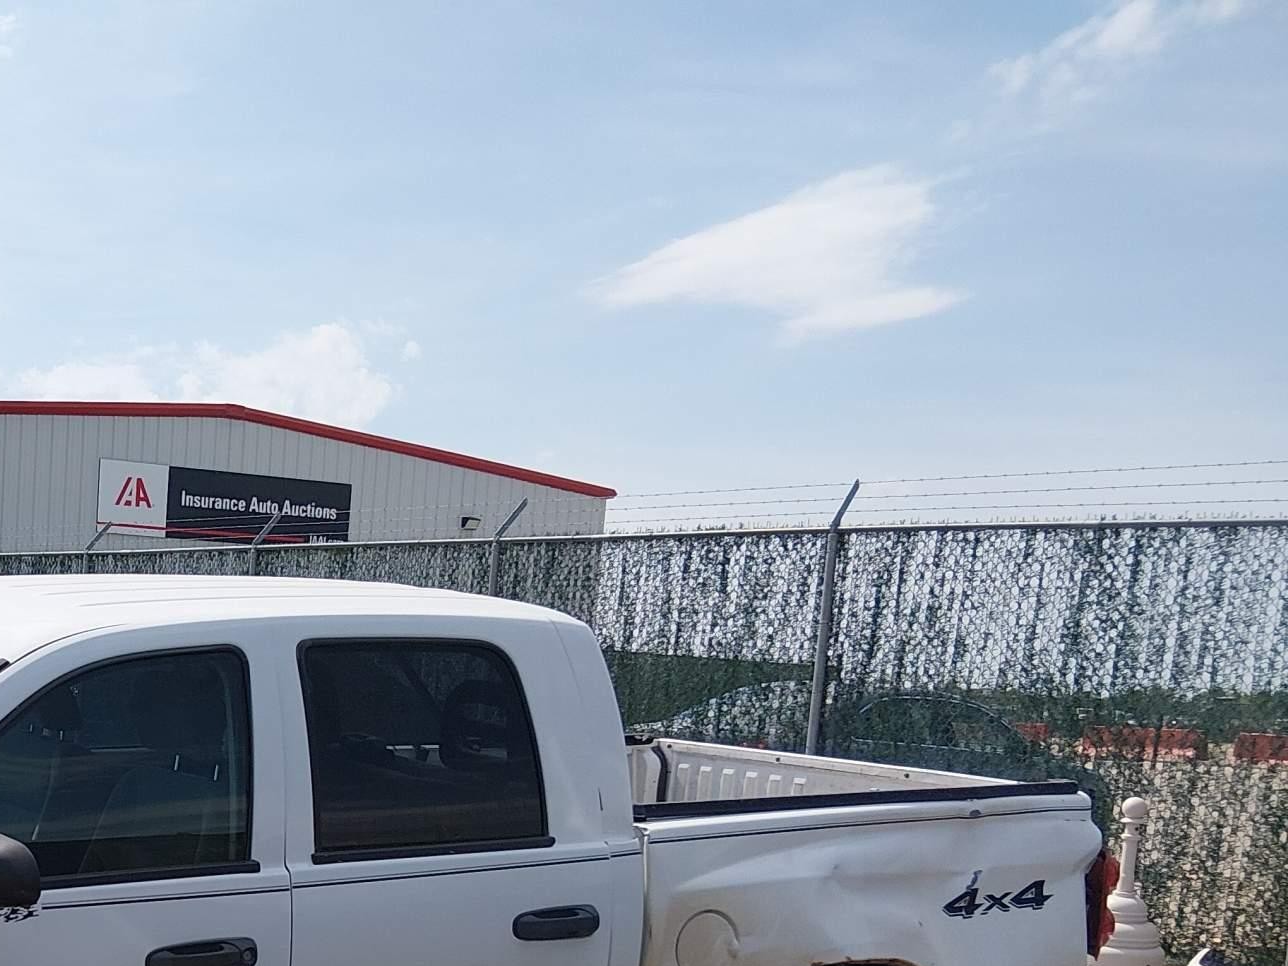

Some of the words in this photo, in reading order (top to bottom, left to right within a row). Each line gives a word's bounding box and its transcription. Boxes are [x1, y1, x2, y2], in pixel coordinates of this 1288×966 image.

[181, 489, 246, 512] Insurance
[249, 496, 279, 515] Auto
[281, 499, 337, 520] Auctions
[942, 879, 1054, 919] 4x4
